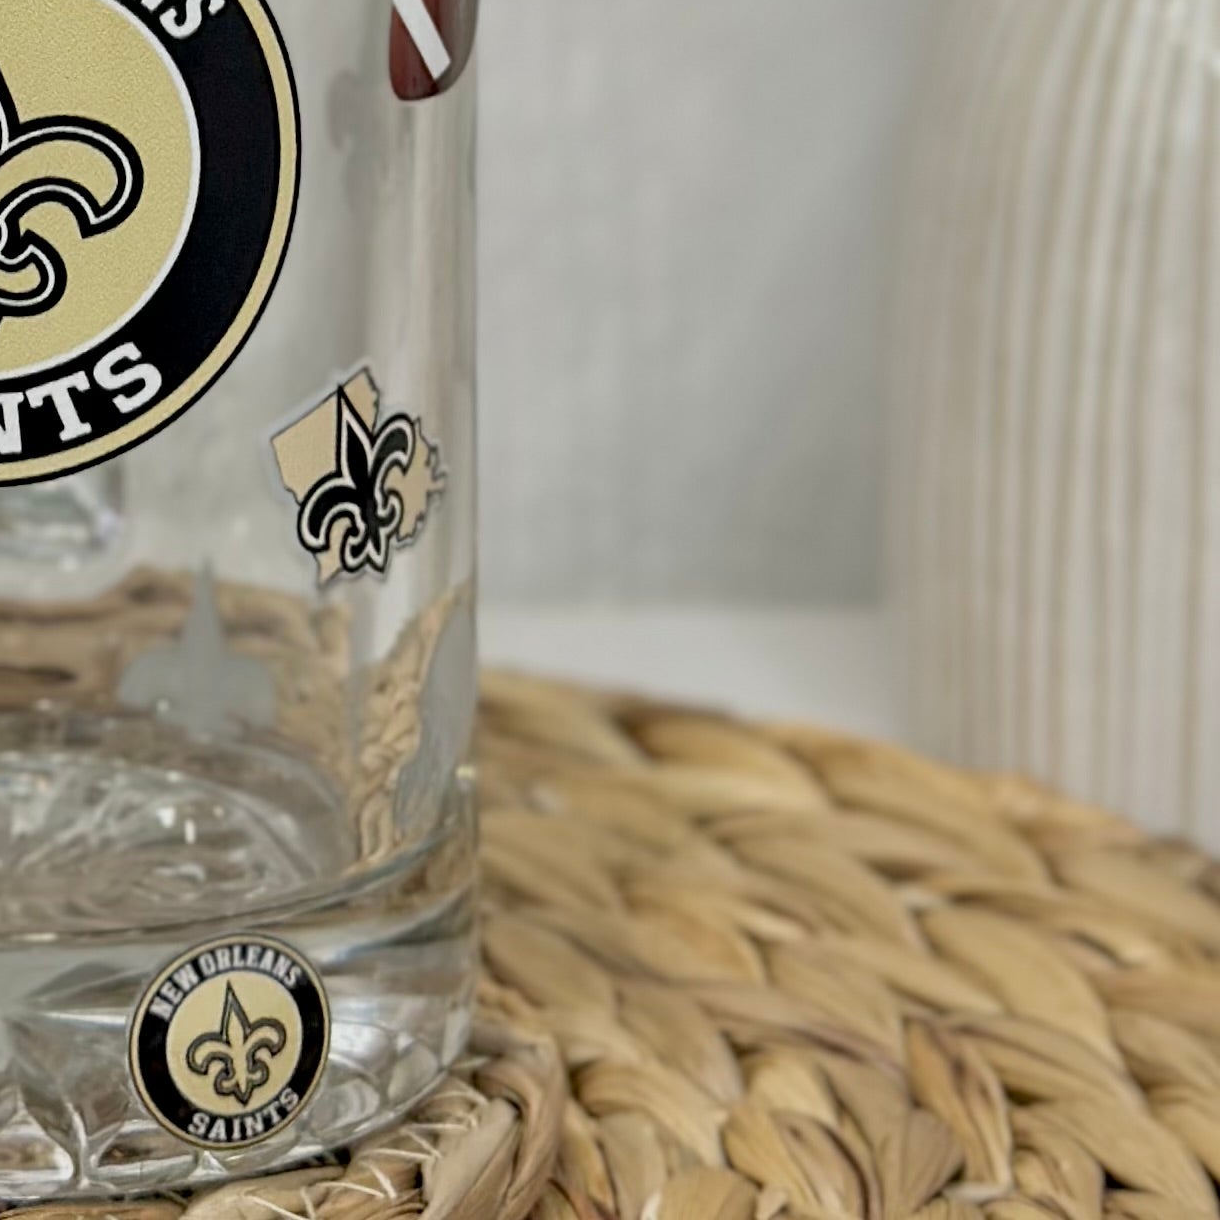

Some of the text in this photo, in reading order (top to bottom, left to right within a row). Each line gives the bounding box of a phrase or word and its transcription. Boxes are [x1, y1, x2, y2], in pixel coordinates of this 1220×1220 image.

[149, 944, 302, 1022] NEW ORLEANS
[187, 1087, 299, 1141] SAINTS
